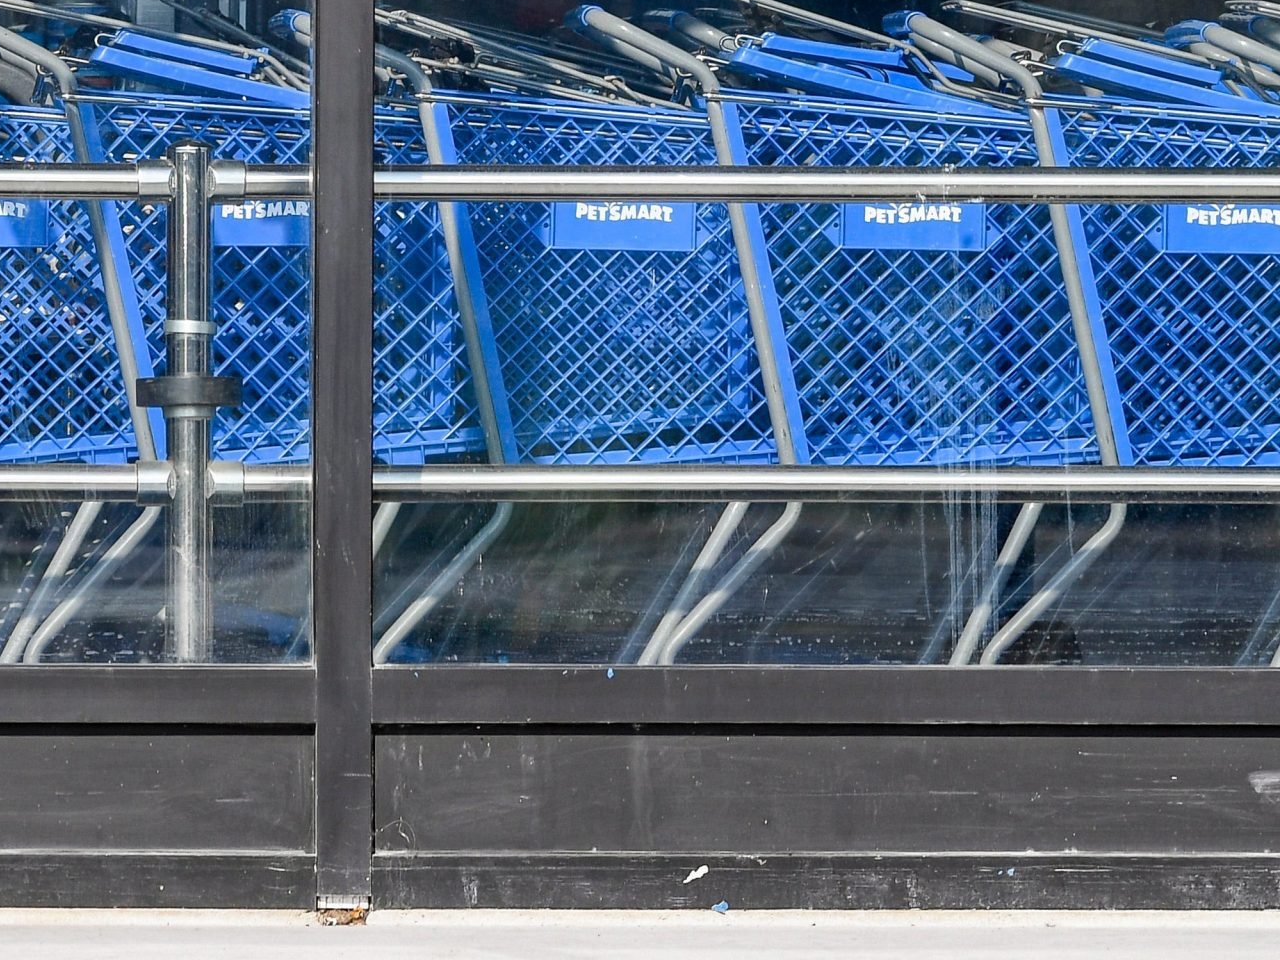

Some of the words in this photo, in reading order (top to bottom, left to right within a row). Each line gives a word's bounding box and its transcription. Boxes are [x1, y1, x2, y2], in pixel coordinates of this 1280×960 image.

[221, 201, 311, 220] PETSMAR
[575, 202, 674, 222] PETSMART
[864, 204, 962, 224] PETSMART
